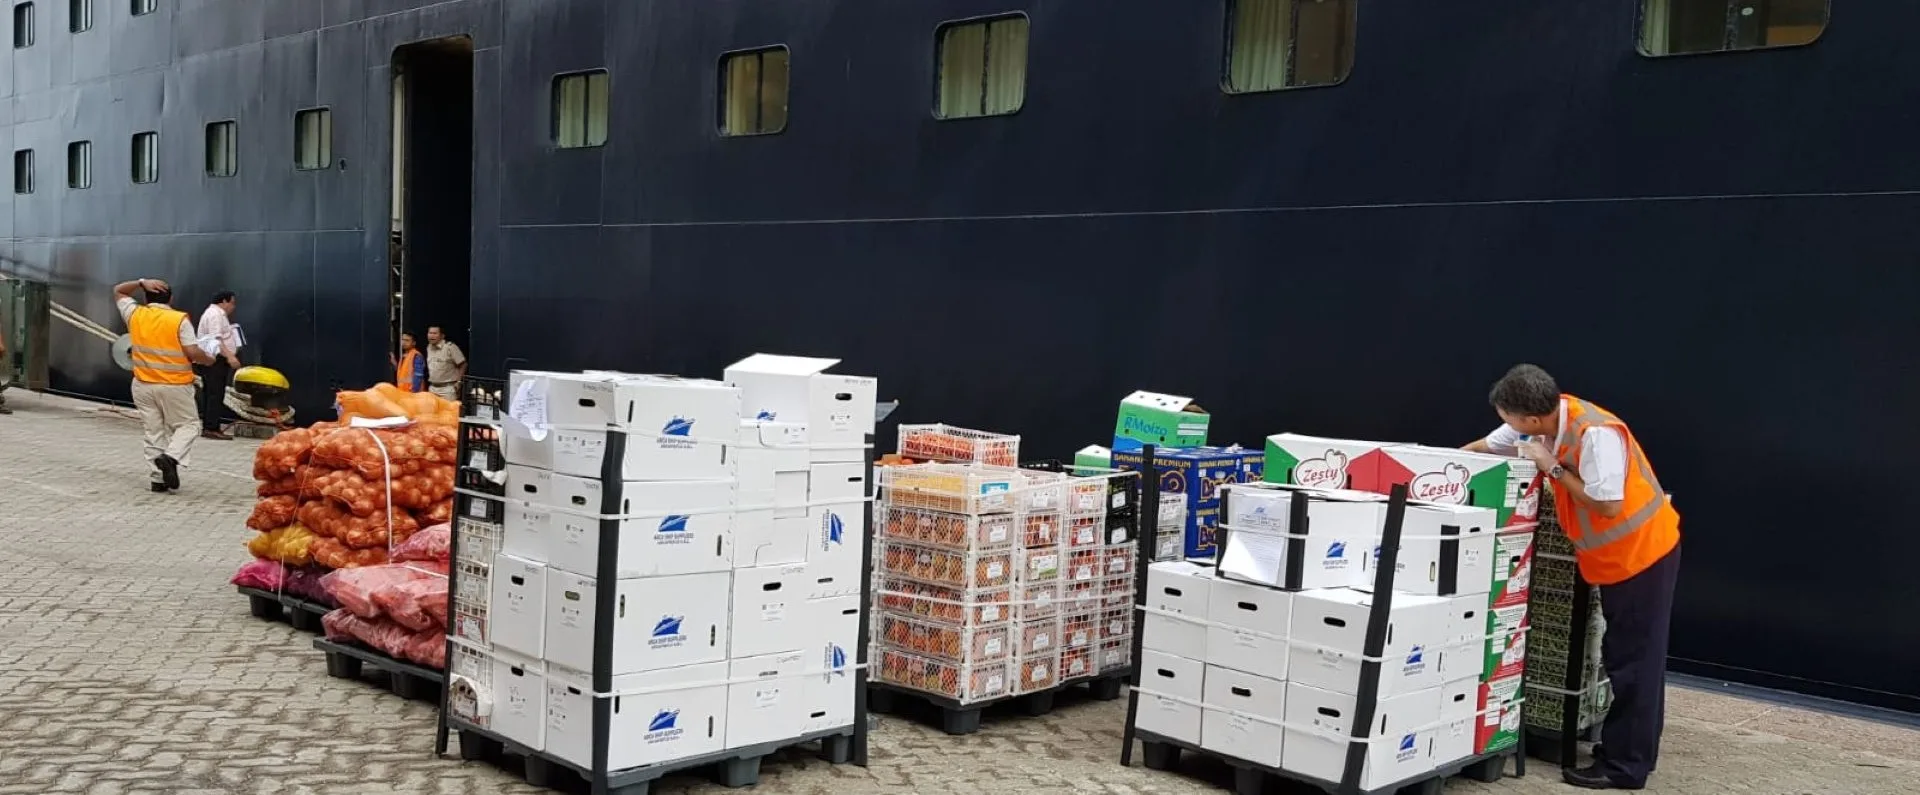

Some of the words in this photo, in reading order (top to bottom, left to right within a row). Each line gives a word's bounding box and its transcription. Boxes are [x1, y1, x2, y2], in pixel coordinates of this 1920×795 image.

[1153, 458, 1191, 468] PREMIUM
[1303, 469, 1338, 483] Zesty
[1420, 482, 1460, 498] Zesty
